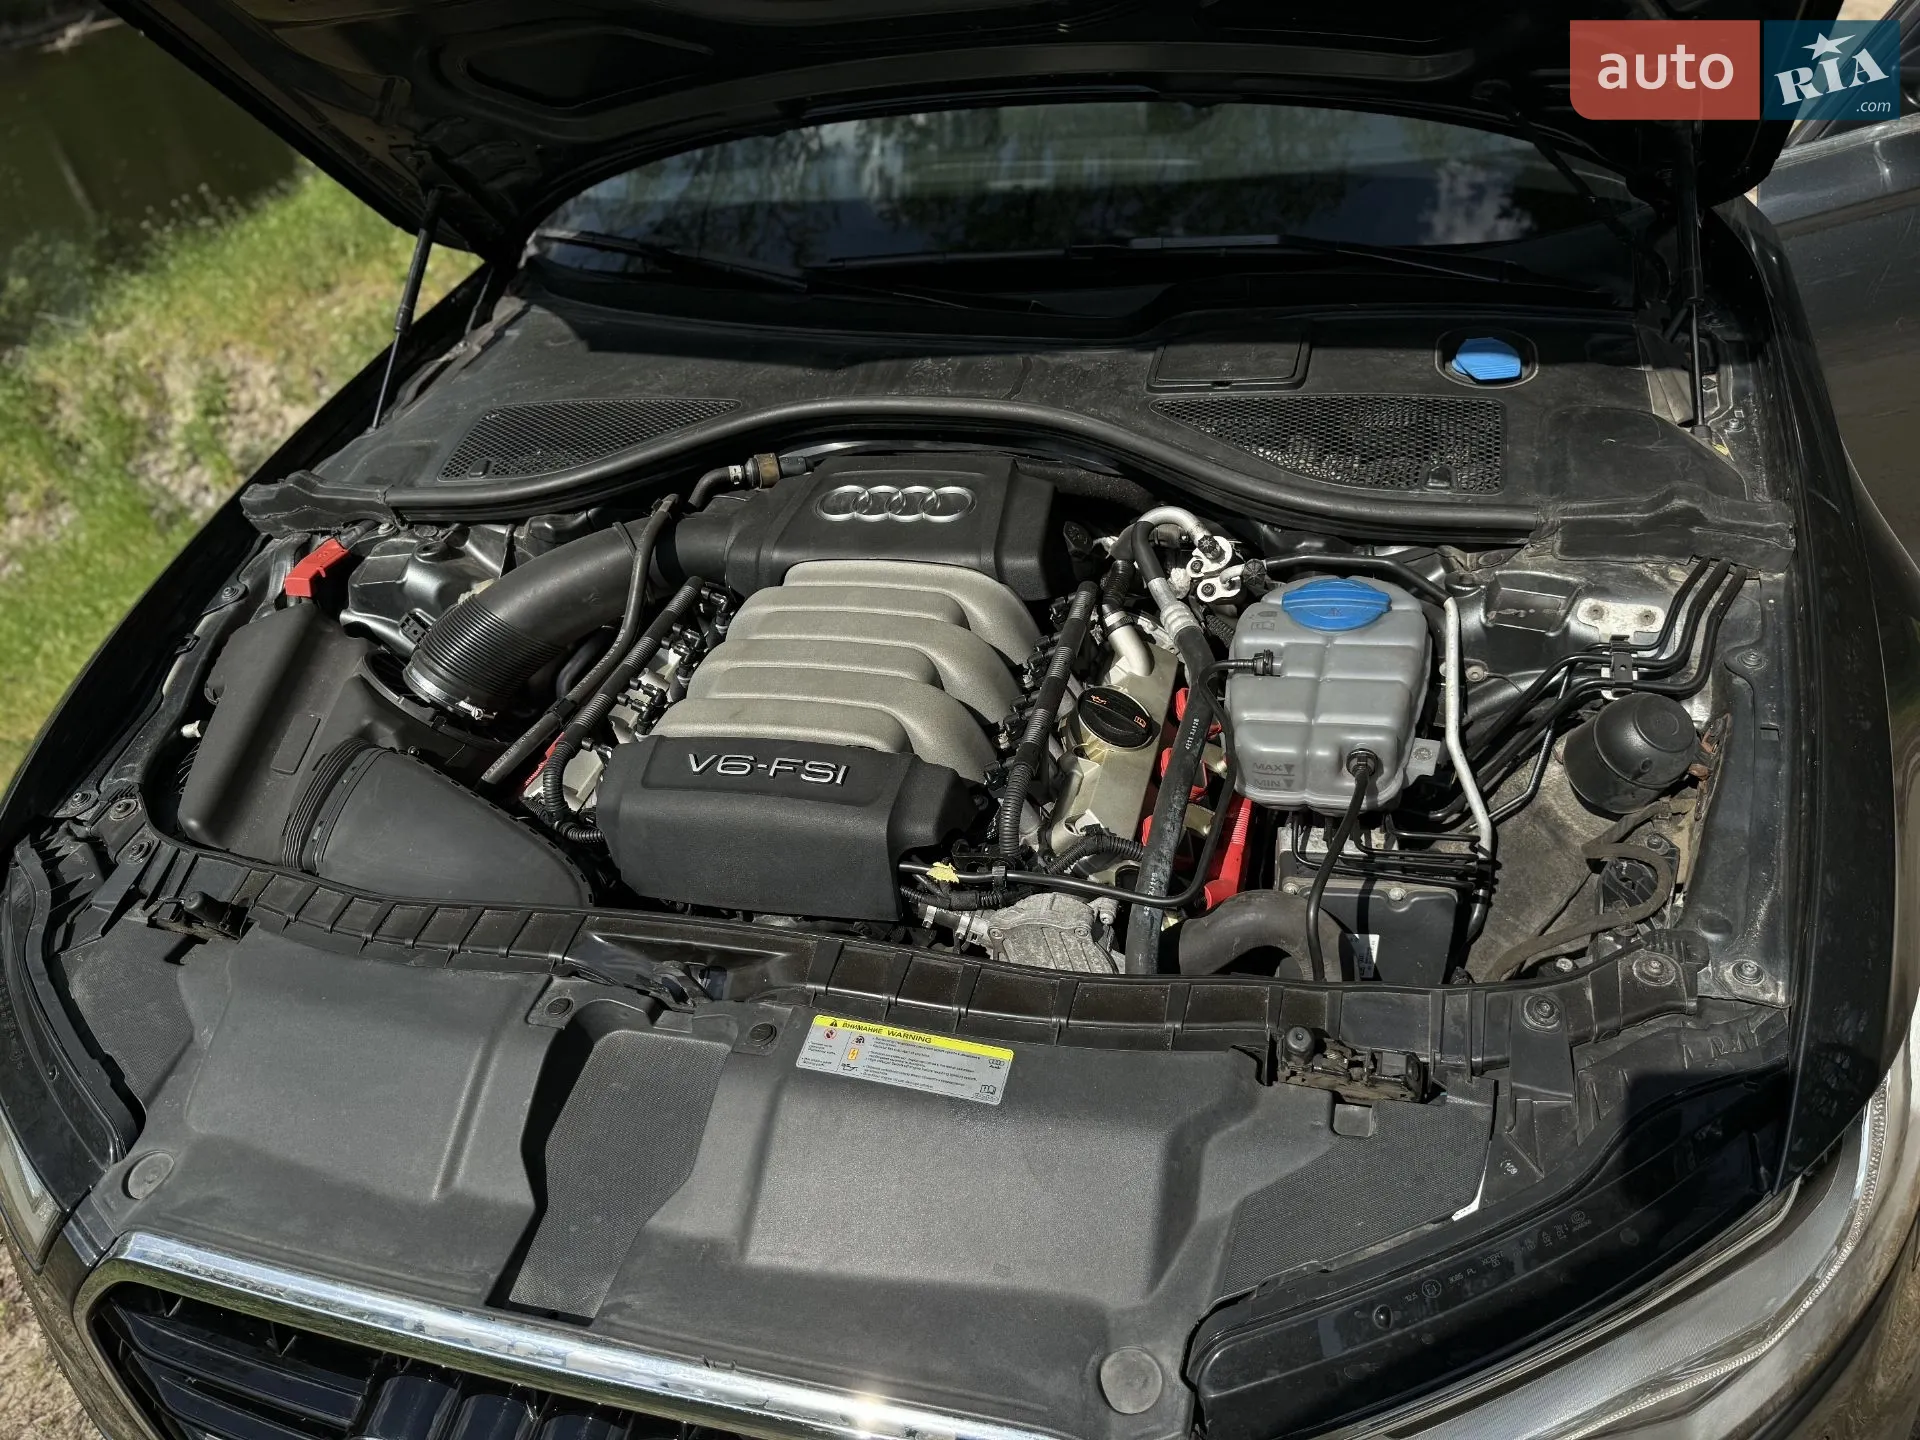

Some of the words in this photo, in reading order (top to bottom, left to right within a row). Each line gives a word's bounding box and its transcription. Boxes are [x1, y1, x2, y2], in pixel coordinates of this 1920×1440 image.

[688, 753, 850, 786] V6-FSI
[1253, 762, 1283, 772] MAX
[1255, 779, 1281, 788] MIN
[841, 1021, 884, 1035] ВНИМАНИЕ
[887, 1030, 933, 1044] WARNING
